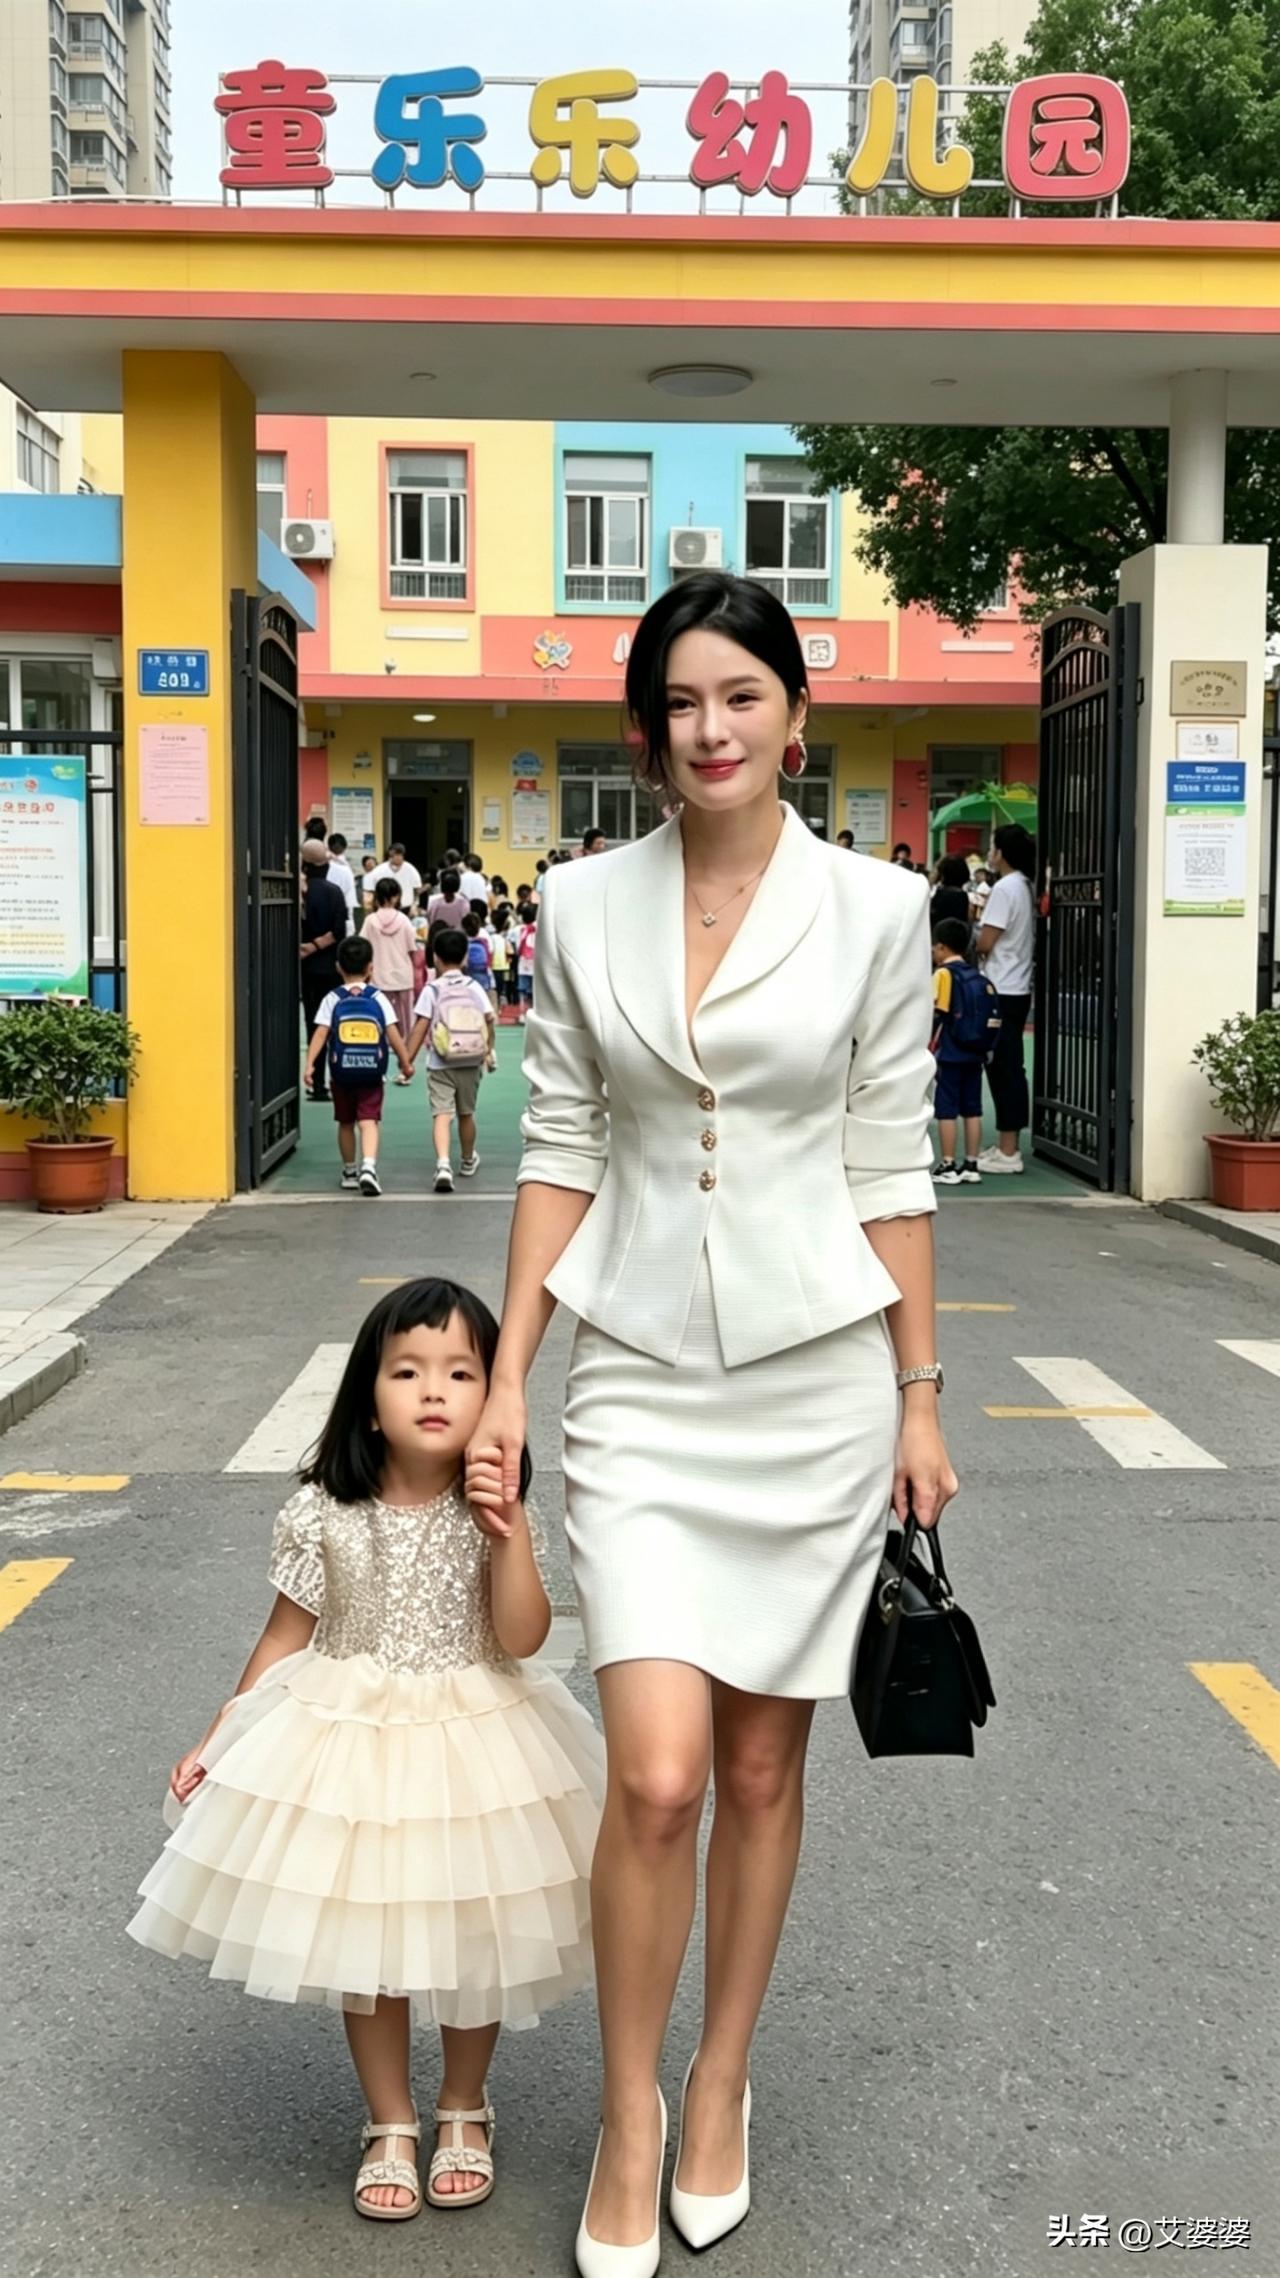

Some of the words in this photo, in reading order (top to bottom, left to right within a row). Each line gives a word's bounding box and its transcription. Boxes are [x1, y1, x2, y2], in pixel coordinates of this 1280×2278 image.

[214, 59, 1131, 200] 童乐乐幼儿园
